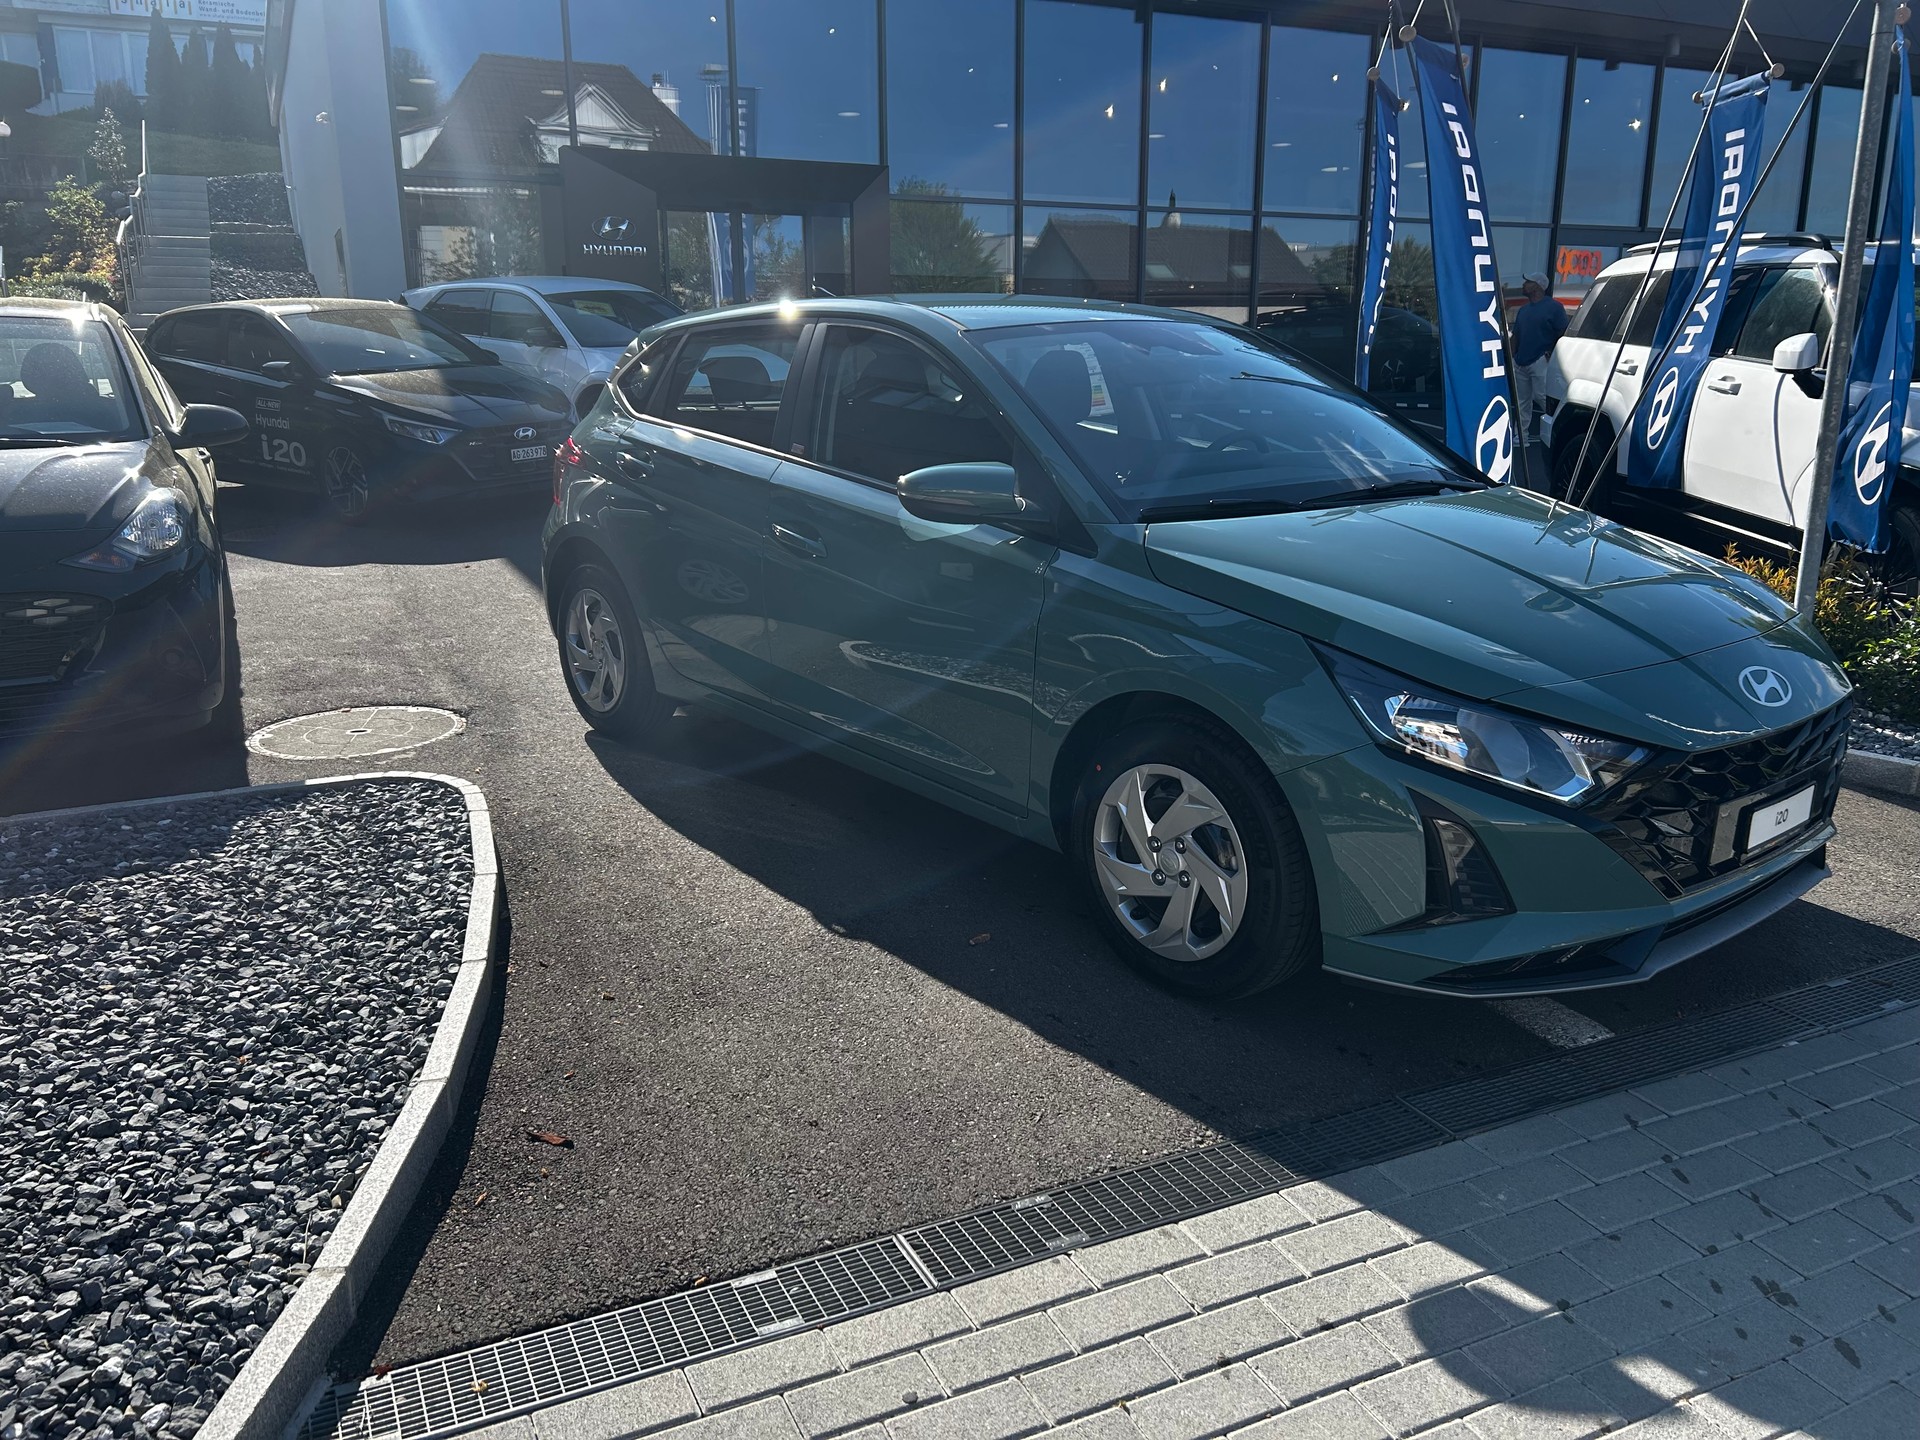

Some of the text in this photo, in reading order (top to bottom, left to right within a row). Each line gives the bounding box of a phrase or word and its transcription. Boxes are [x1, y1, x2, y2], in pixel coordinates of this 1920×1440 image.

[583, 244, 647, 256] HYUNDAI
[255, 413, 290, 429] Hyundai
[261, 434, 306, 467] i20
[1774, 808, 1789, 827] i20
